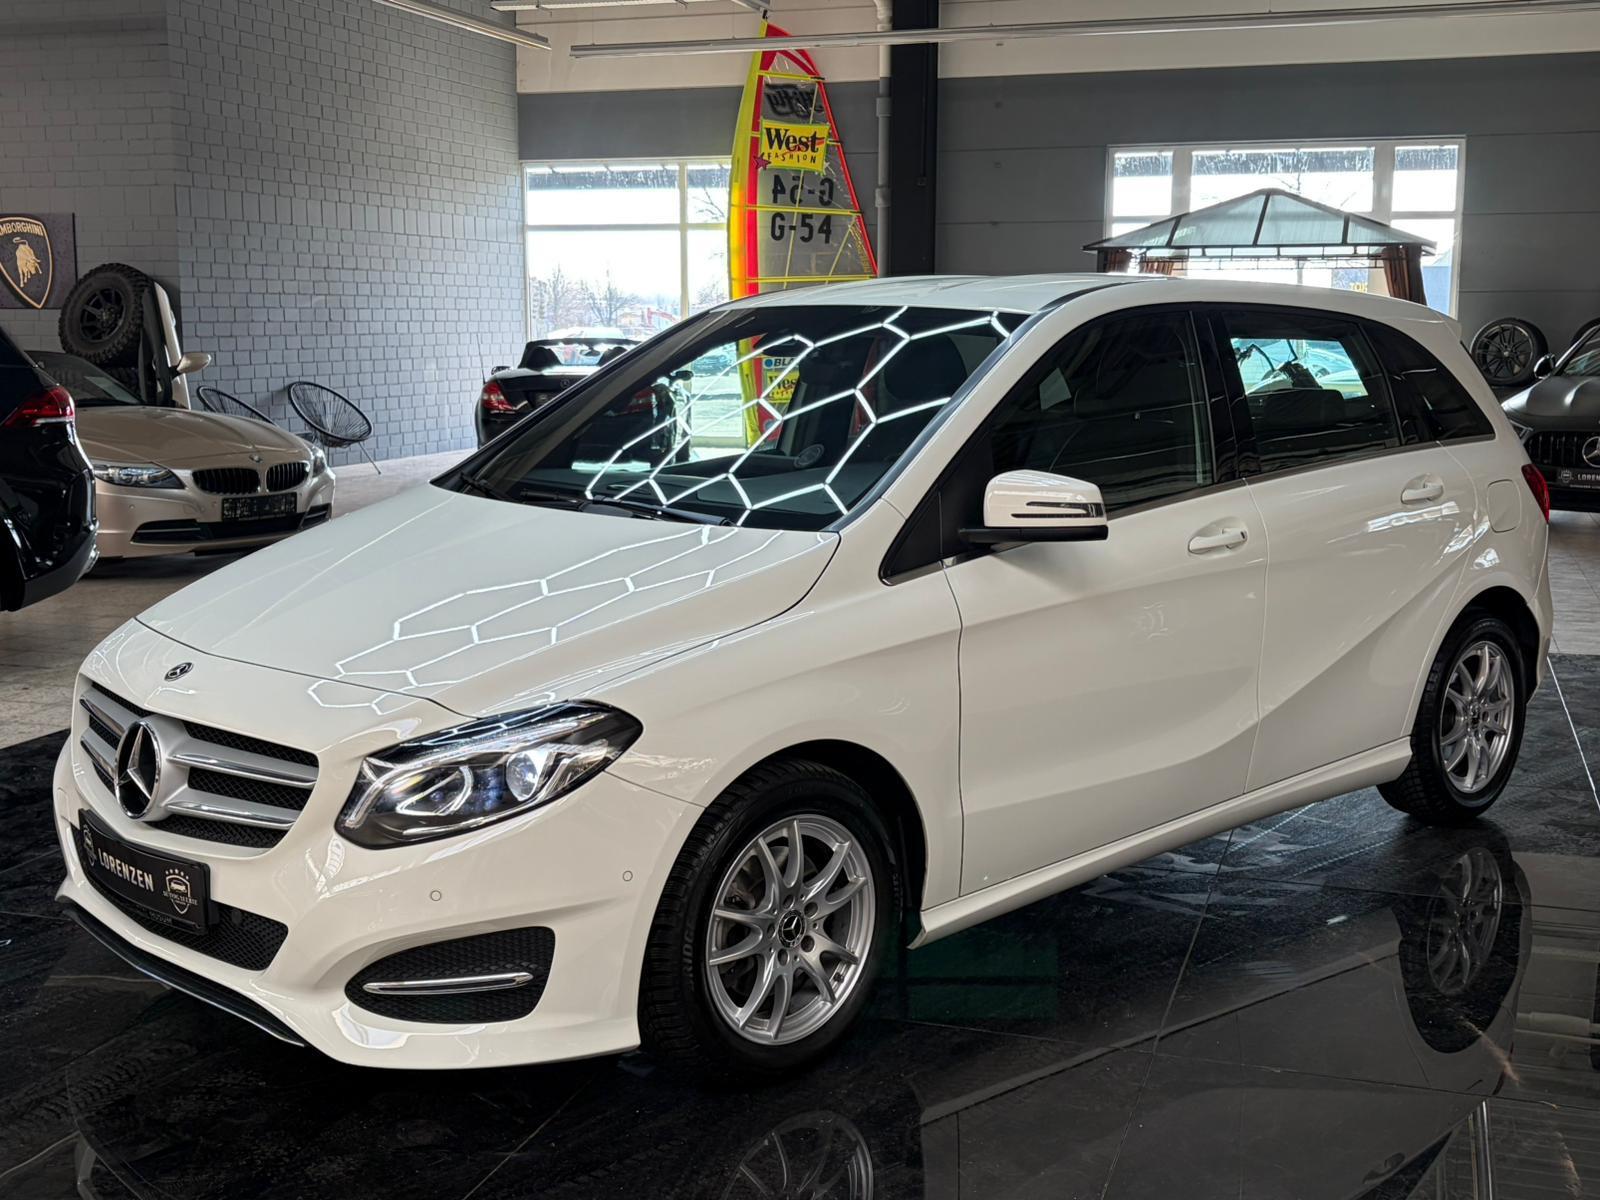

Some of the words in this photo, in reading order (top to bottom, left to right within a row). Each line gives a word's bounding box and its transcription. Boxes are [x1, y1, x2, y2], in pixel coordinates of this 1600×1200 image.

[765, 127, 825, 153] West
[767, 152, 817, 164] FASHION
[770, 212, 832, 244] G-54
[98, 848, 154, 892] LORENZEN
